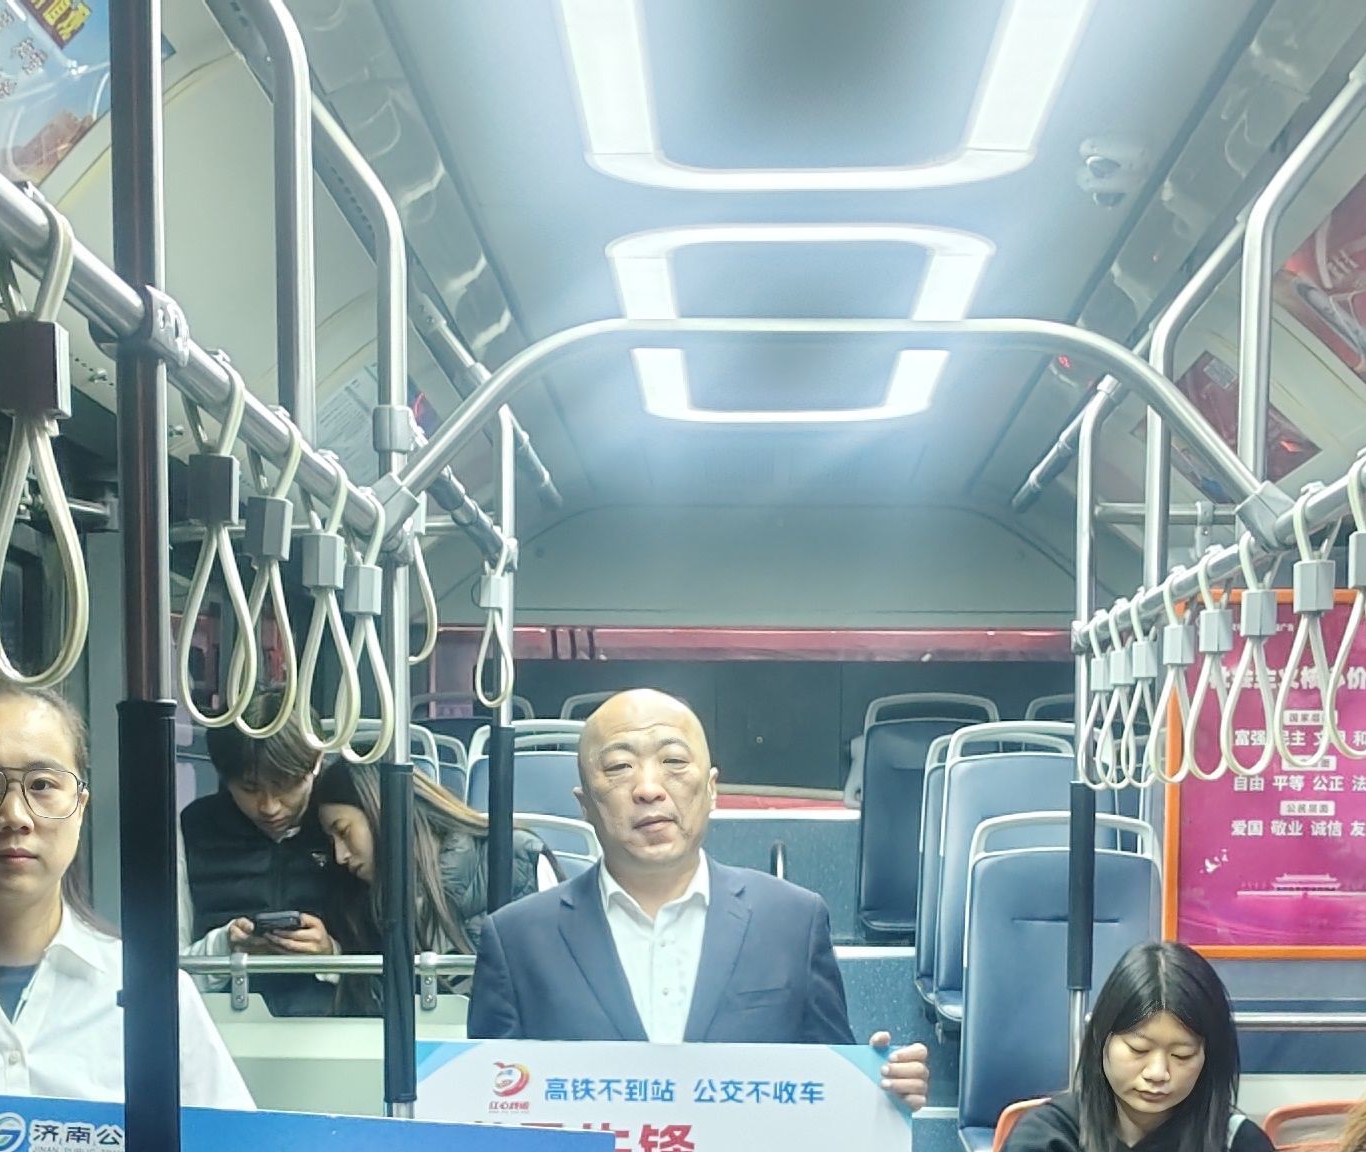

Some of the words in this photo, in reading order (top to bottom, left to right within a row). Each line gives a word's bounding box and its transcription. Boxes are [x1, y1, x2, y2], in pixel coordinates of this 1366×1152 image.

[1234, 776, 1264, 791] 自由
[1273, 775, 1305, 791] 平等
[1313, 775, 1344, 792] 公正
[1231, 820, 1263, 836] 爱国
[1271, 820, 1303, 836] 敬业
[1311, 820, 1343, 837] 诚信
[544, 1078, 676, 1101] 高铁不到站
[693, 1078, 825, 1104] 公交不收车
